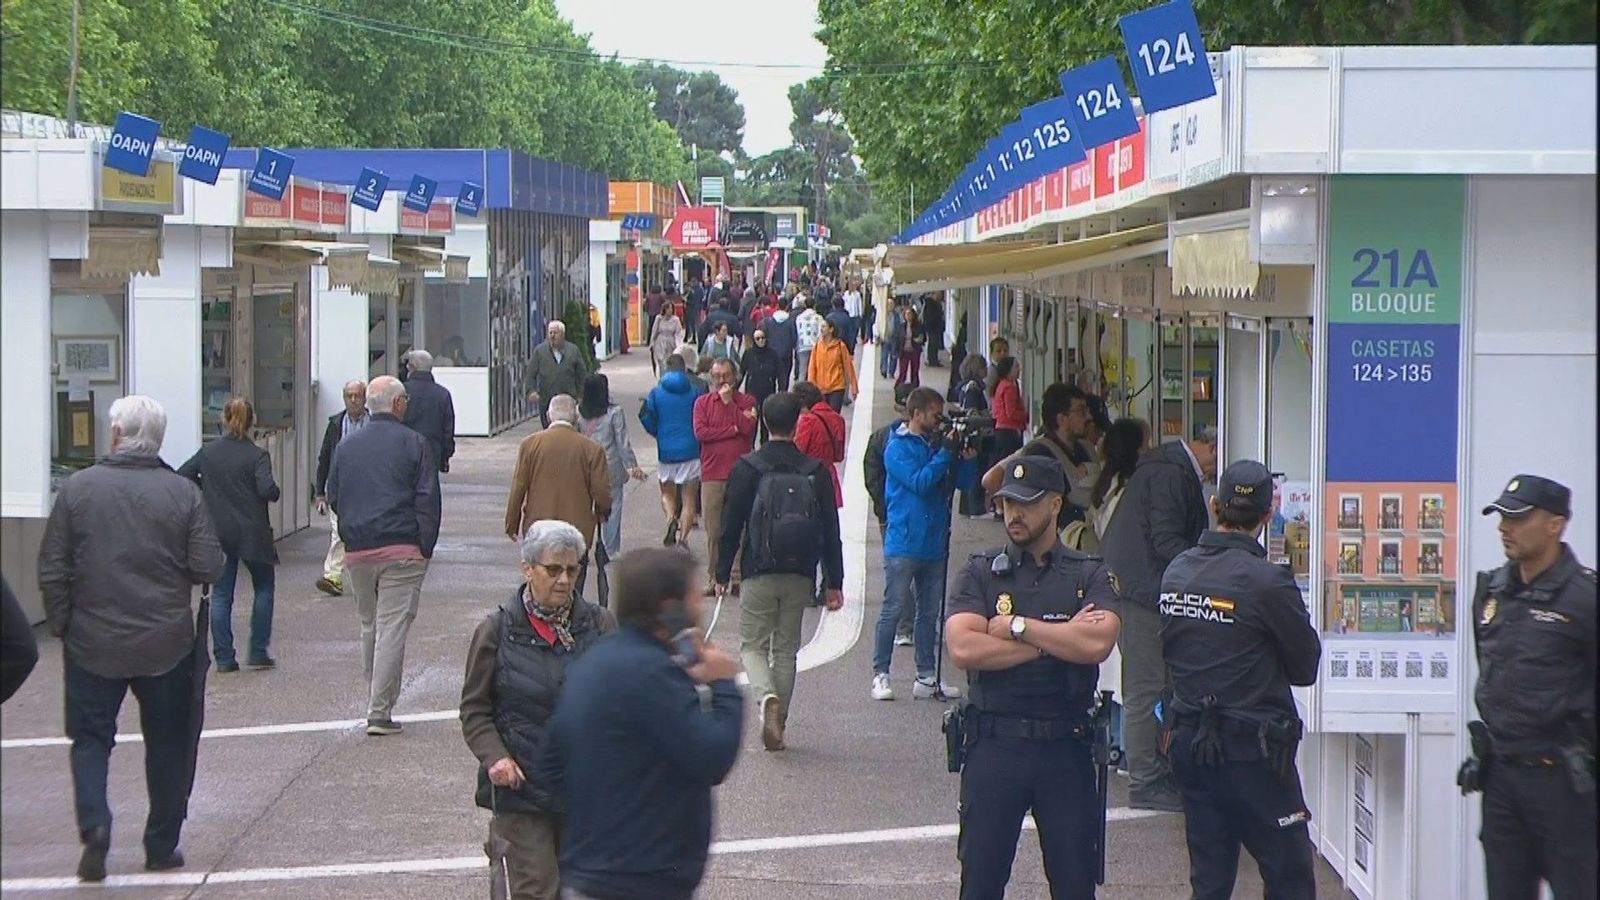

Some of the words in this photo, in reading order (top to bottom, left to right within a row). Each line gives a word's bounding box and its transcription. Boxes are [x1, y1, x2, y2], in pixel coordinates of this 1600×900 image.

[1138, 32, 1196, 76] 124
[1076, 83, 1122, 121] 124
[1033, 118, 1072, 150] 125
[111, 133, 151, 158] OAPN
[185, 145, 221, 168] OAPN
[270, 160, 277, 175] 1
[367, 178, 377, 192] 2
[418, 183, 426, 195] 3
[467, 190, 475, 201] 4
[1351, 248, 1439, 288] 21A
[1351, 293, 1436, 314] BLOQUE
[1351, 339, 1435, 358] CASETAS
[1235, 485, 1254, 496] CNP
[1159, 593, 1212, 608] POLICIA
